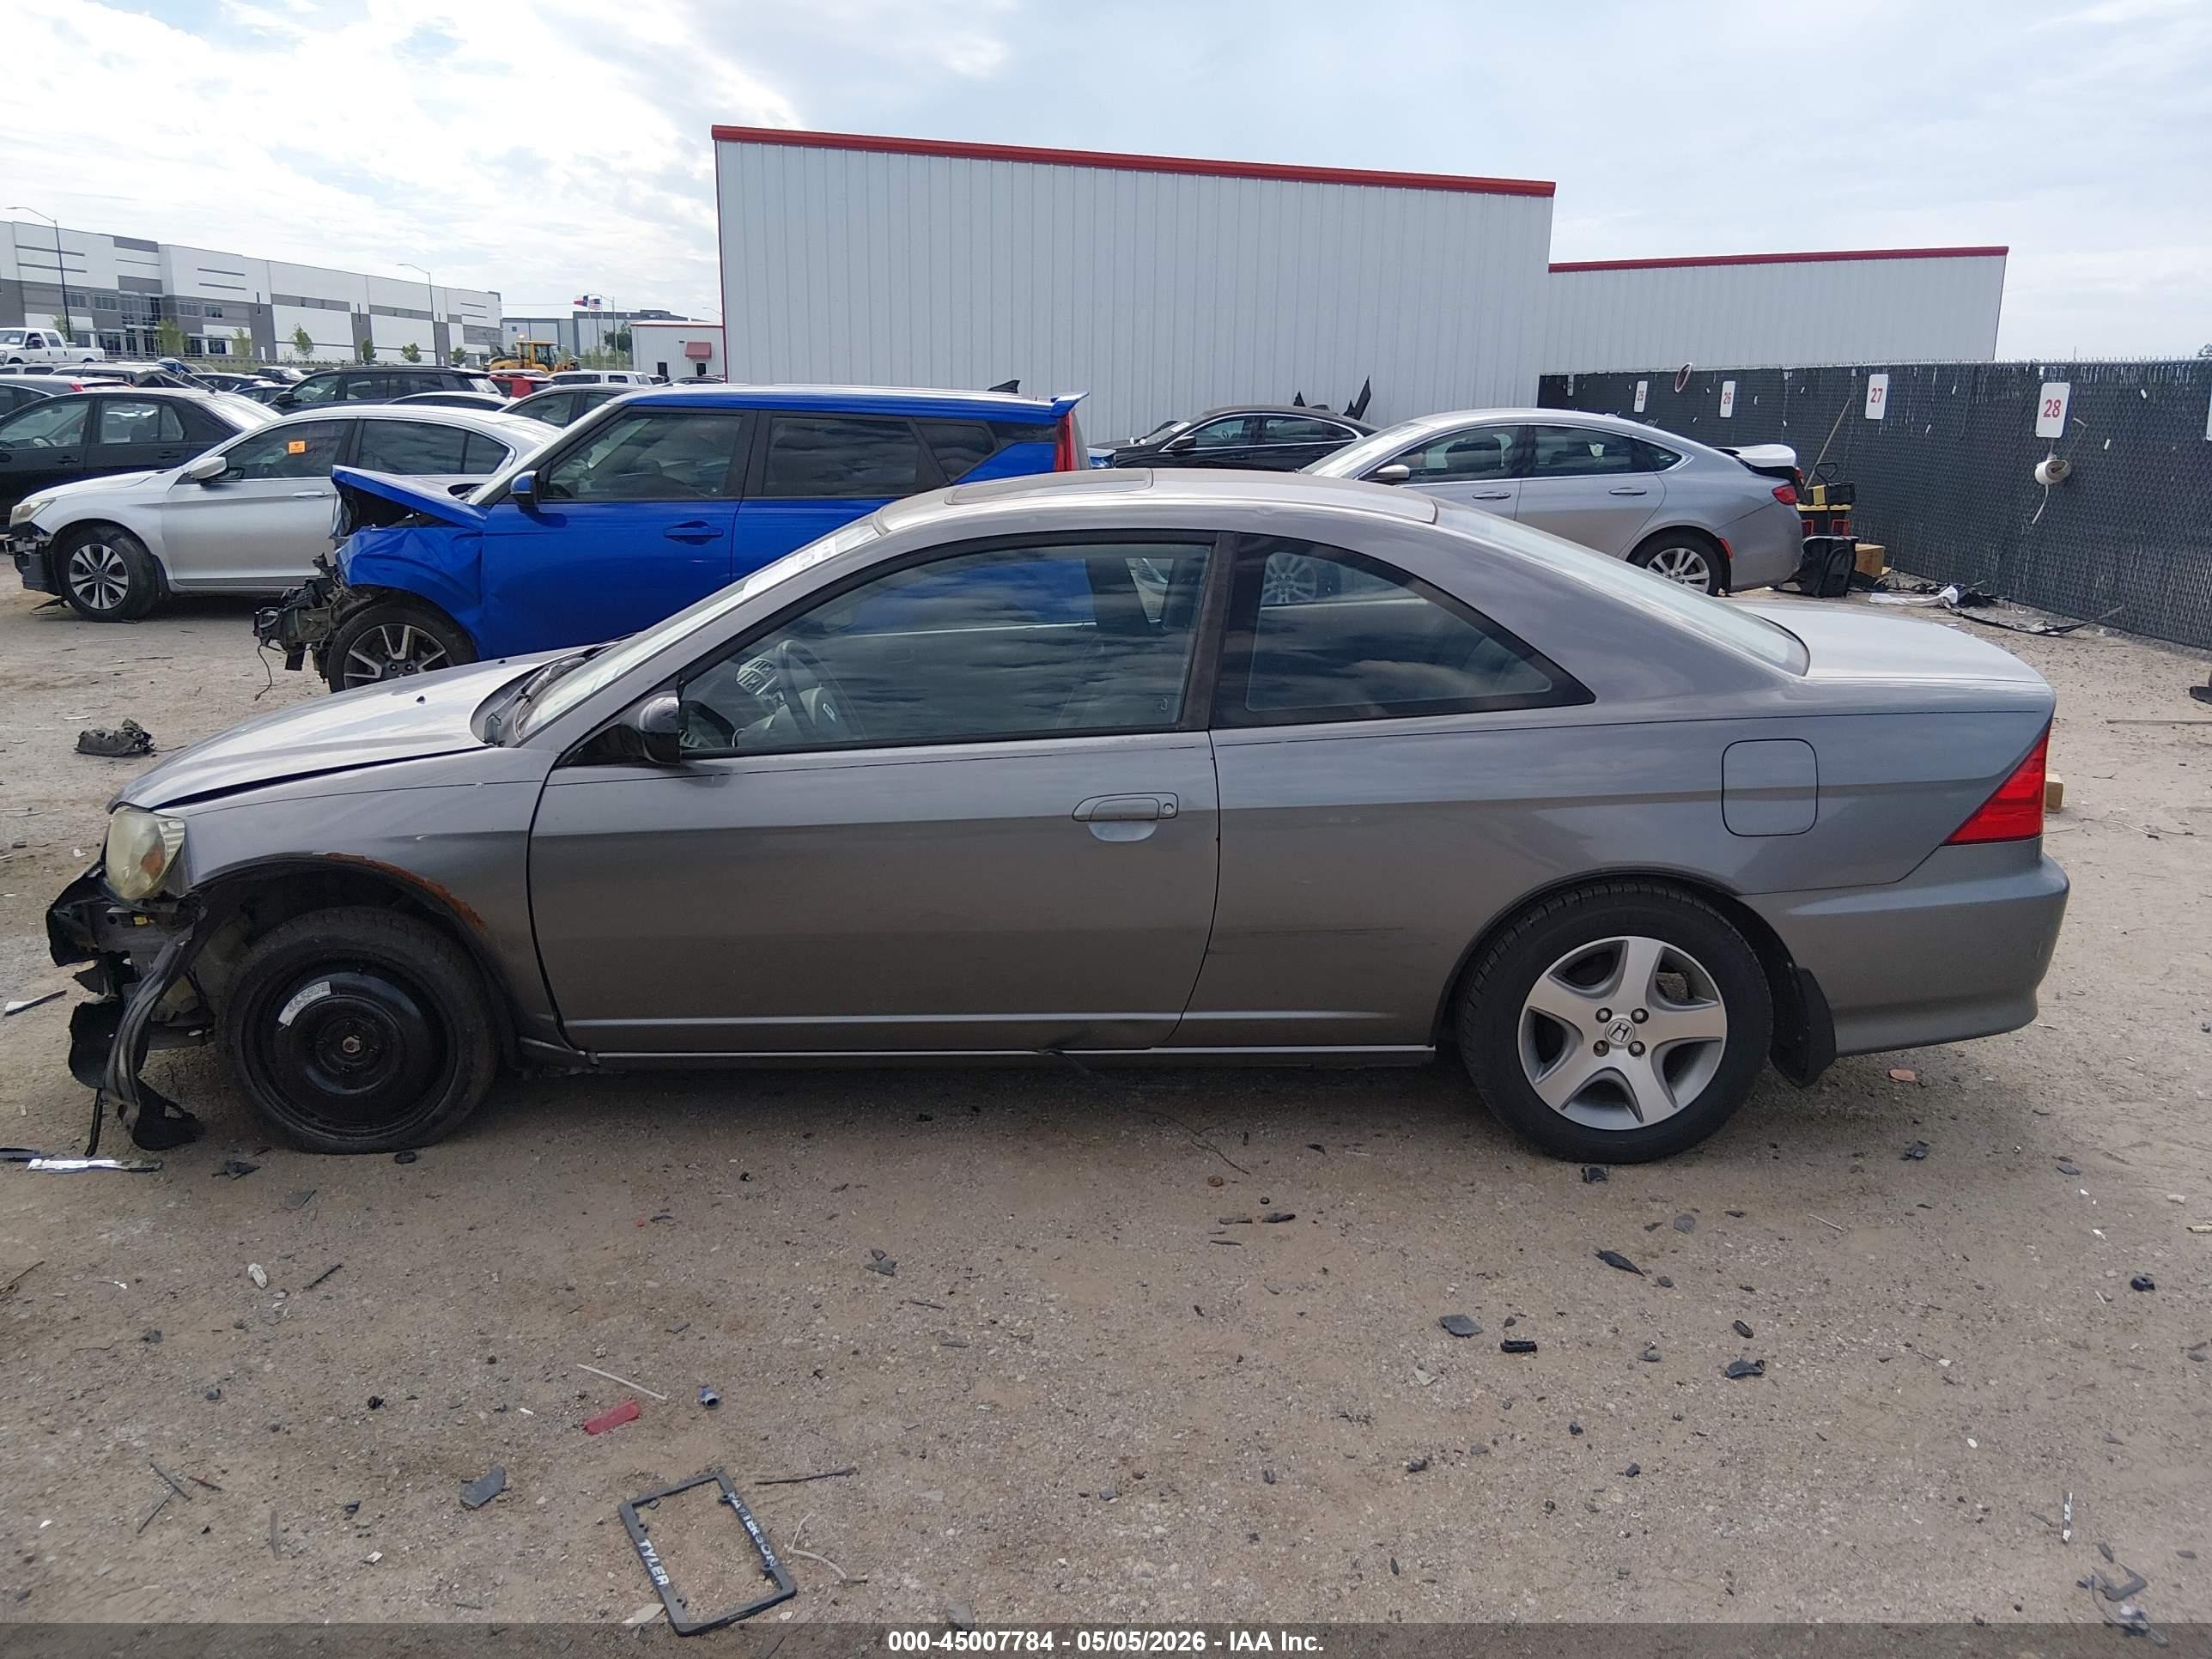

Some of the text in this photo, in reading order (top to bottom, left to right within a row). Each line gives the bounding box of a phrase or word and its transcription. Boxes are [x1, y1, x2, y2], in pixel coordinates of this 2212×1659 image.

[1723, 392, 1732, 404] 26
[1870, 387, 1883, 404] 27
[2043, 398, 2062, 418] 28
[638, 1538, 670, 1586] TYLER
